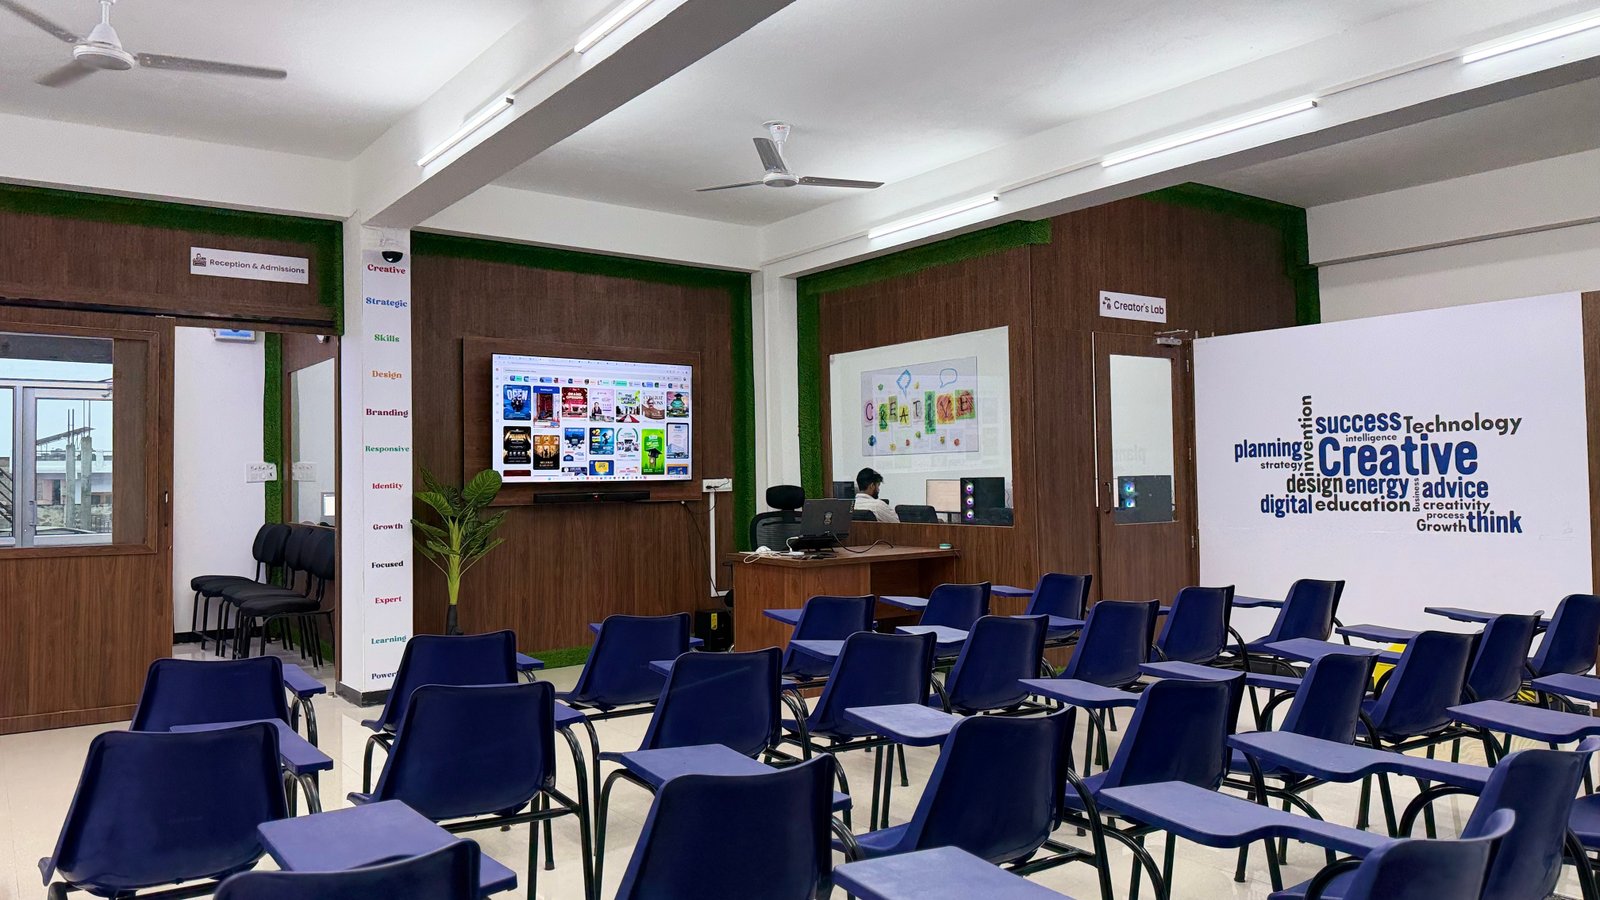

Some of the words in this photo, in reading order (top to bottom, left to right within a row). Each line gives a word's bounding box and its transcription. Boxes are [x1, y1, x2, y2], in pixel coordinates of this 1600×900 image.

[209, 259, 251, 269] Reception
[252, 262, 259, 270] &
[260, 263, 305, 274] Admissions
[367, 263, 406, 275] Creative
[365, 297, 408, 308] Strategic
[1113, 300, 1150, 313] Creator's
[1150, 304, 1165, 315] Lab
[374, 333, 400, 343] Skills
[371, 370, 402, 380] Design
[506, 388, 528, 401] OPEN
[365, 408, 409, 419] Branding
[865, 392, 971, 431] CREATIVE
[1315, 412, 1402, 434] success
[1403, 412, 1522, 435] Technology
[1298, 395, 1314, 477] invention
[1345, 433, 1398, 443] intelligence
[365, 445, 410, 454] Responsive
[1234, 438, 1303, 462] planning
[1318, 433, 1478, 477] Creative
[1260, 461, 1303, 471] strategy
[372, 482, 404, 491] Identity
[1286, 473, 1343, 497] design
[1345, 477, 1409, 499] energy
[1422, 476, 1489, 498] advice
[1412, 477, 1420, 512] Business
[1260, 494, 1313, 518] digital
[1315, 496, 1411, 512] education
[1422, 499, 1491, 514] creativity
[1426, 512, 1465, 522] process
[1466, 510, 1523, 533] think
[372, 522, 404, 531] Growth
[1416, 518, 1467, 532] Growth
[371, 560, 404, 569] Focused
[374, 595, 402, 605] Expert
[370, 635, 407, 645] Learning
[371, 671, 397, 680] Power
